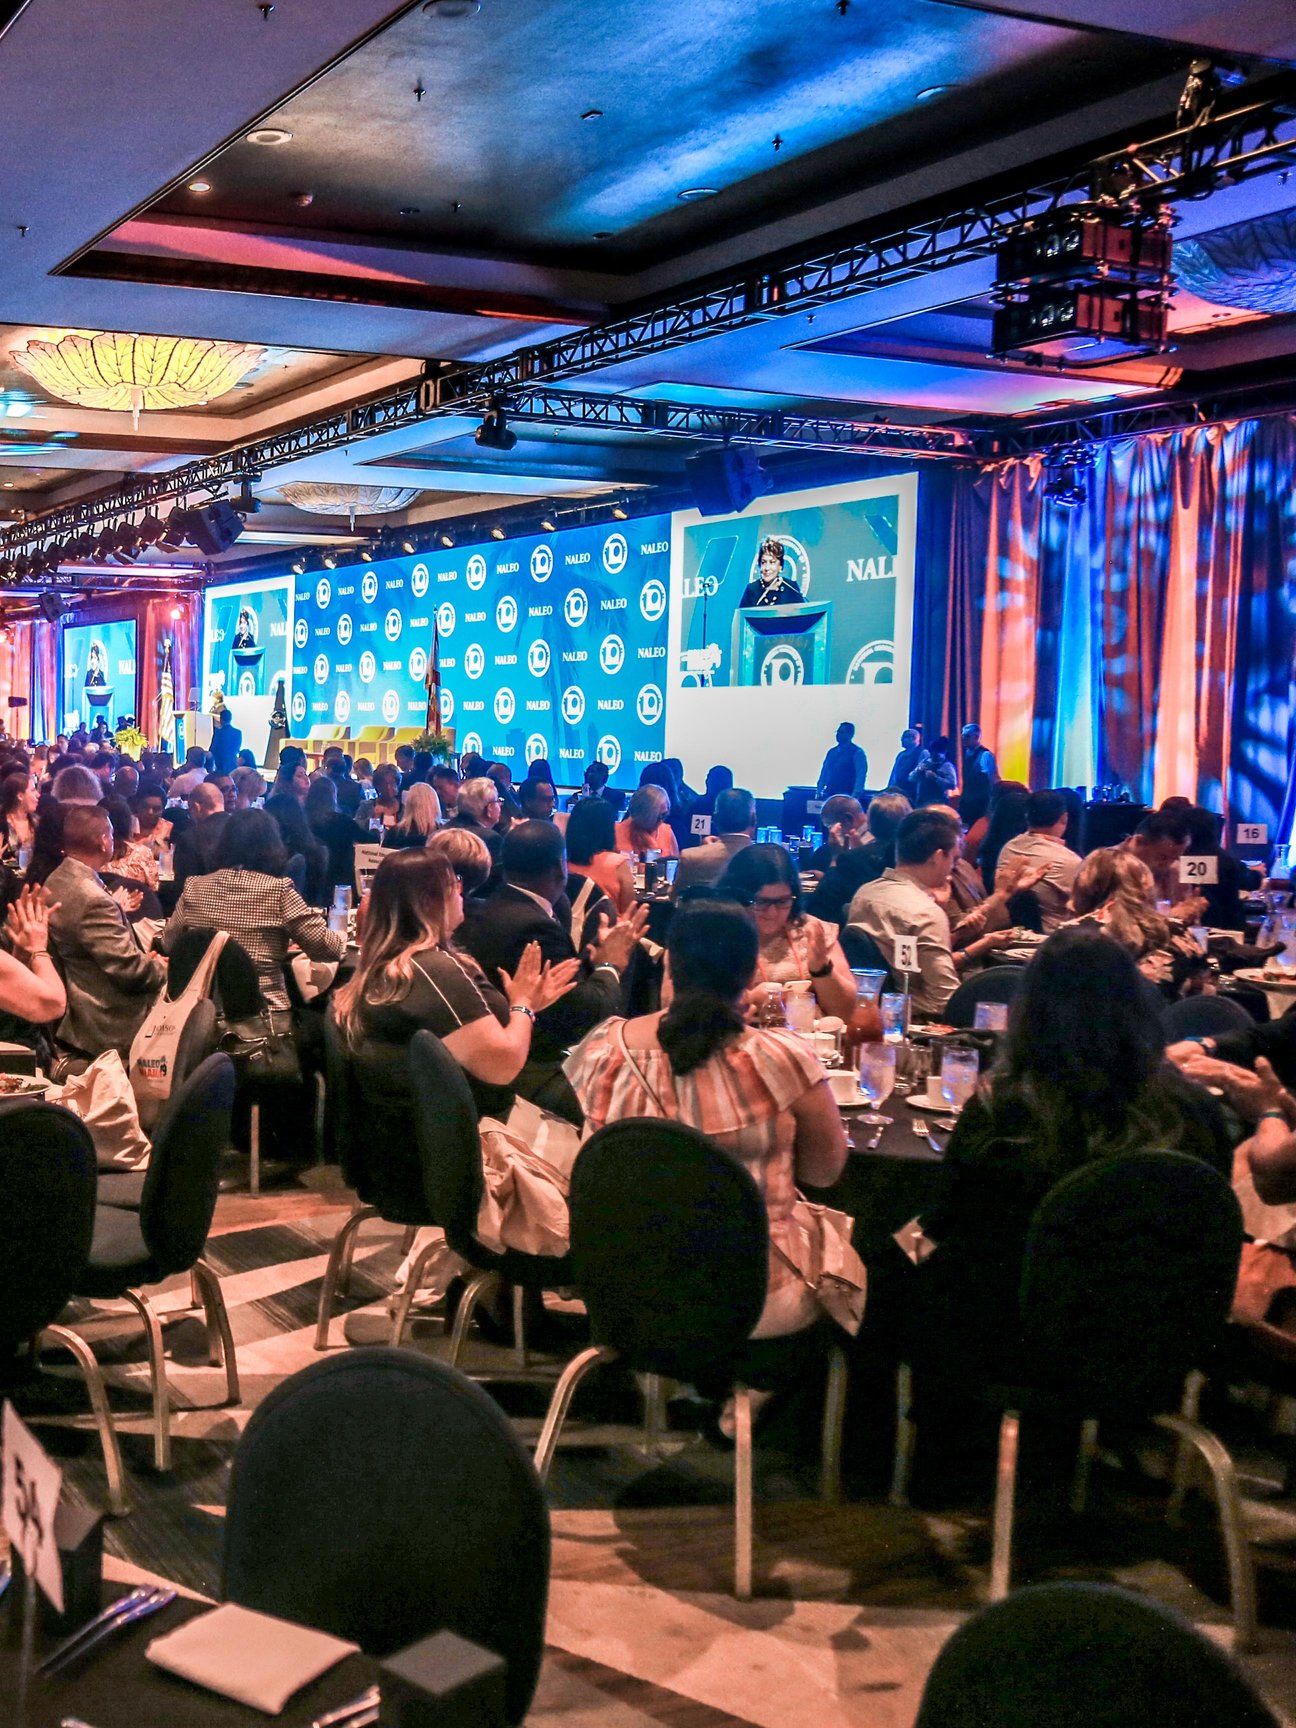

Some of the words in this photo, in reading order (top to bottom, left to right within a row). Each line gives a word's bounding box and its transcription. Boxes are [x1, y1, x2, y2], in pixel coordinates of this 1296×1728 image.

[641, 541, 668, 555] NALEO
[565, 553, 590, 565] NALEO
[497, 563, 519, 574] NALEO
[438, 571, 457, 582] NALEO
[386, 579, 403, 589] NALEO
[338, 586, 354, 595] NALEO
[295, 592, 310, 601] NALEO
[601, 598, 627, 610] NALEO
[529, 606, 552, 617] NALEO
[465, 612, 486, 622] NALEO
[360, 622, 377, 632] NALEO
[410, 618, 428, 627] NALEO
[315, 628, 330, 636] NALEO
[563, 651, 587, 661] NALEO
[638, 647, 666, 658] NALEO
[495, 655, 517, 665] NALEO
[293, 666, 308, 674] NALEO
[336, 664, 352, 672] NALEO
[383, 661, 402, 670] NALEO
[312, 702, 328, 711] NALEO
[358, 702, 375, 711] NALEO
[408, 702, 426, 711] NALEO
[463, 701, 484, 711] NALEO
[526, 700, 550, 710] NALEO
[598, 699, 624, 710] NALEO
[493, 746, 514, 756] NALEO
[560, 748, 584, 759] NALEO
[634, 751, 662, 762] NALEO
[695, 819, 705, 829] 21
[1244, 828, 1260, 838] 16
[1187, 862, 1207, 876] 20
